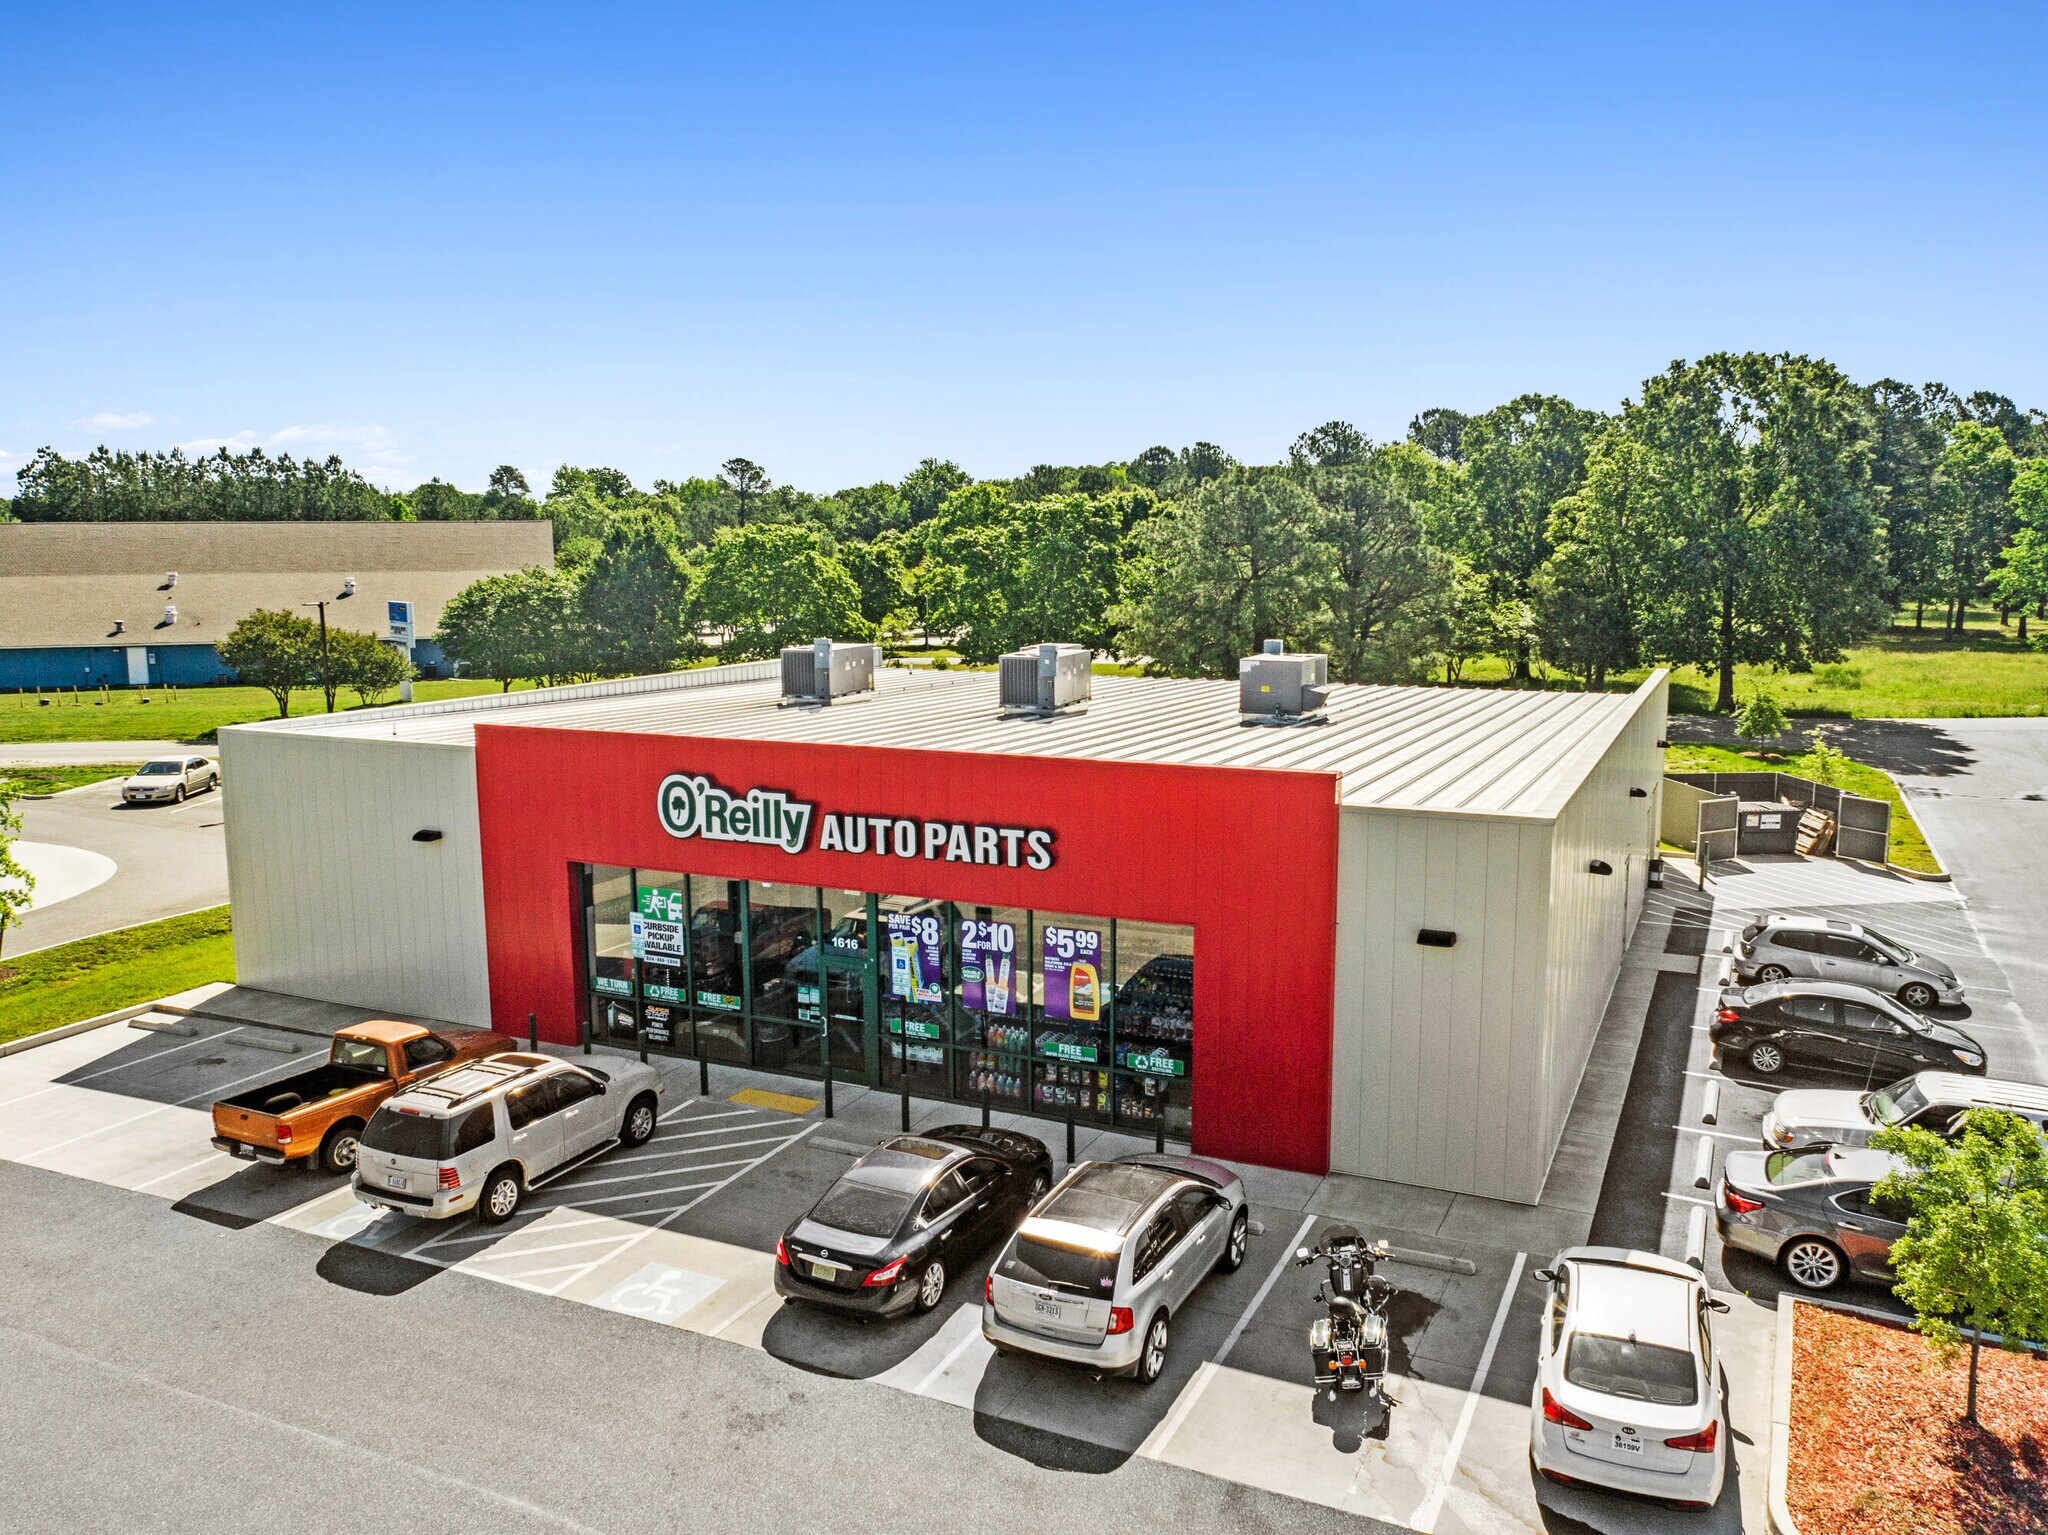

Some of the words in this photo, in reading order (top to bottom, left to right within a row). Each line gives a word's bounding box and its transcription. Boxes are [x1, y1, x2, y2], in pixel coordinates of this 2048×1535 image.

[659, 776, 808, 850] O'Reilly
[820, 814, 916, 858] AUTO
[924, 823, 1051, 870] PARTS
[888, 914, 911, 925] SAVE
[911, 916, 939, 945] $8
[962, 921, 977, 949] 2
[977, 941, 991, 950] FOR
[648, 932, 675, 942] PICKUP
[832, 936, 858, 950] 1616
[597, 977, 609, 987] WE
[609, 978, 628, 990] TURN
[660, 986, 679, 997] FREE
[703, 992, 721, 1003] FREE
[905, 1021, 925, 1033] FREE
[1058, 1043, 1082, 1056] FREE
[1150, 1057, 1175, 1070] FREE
